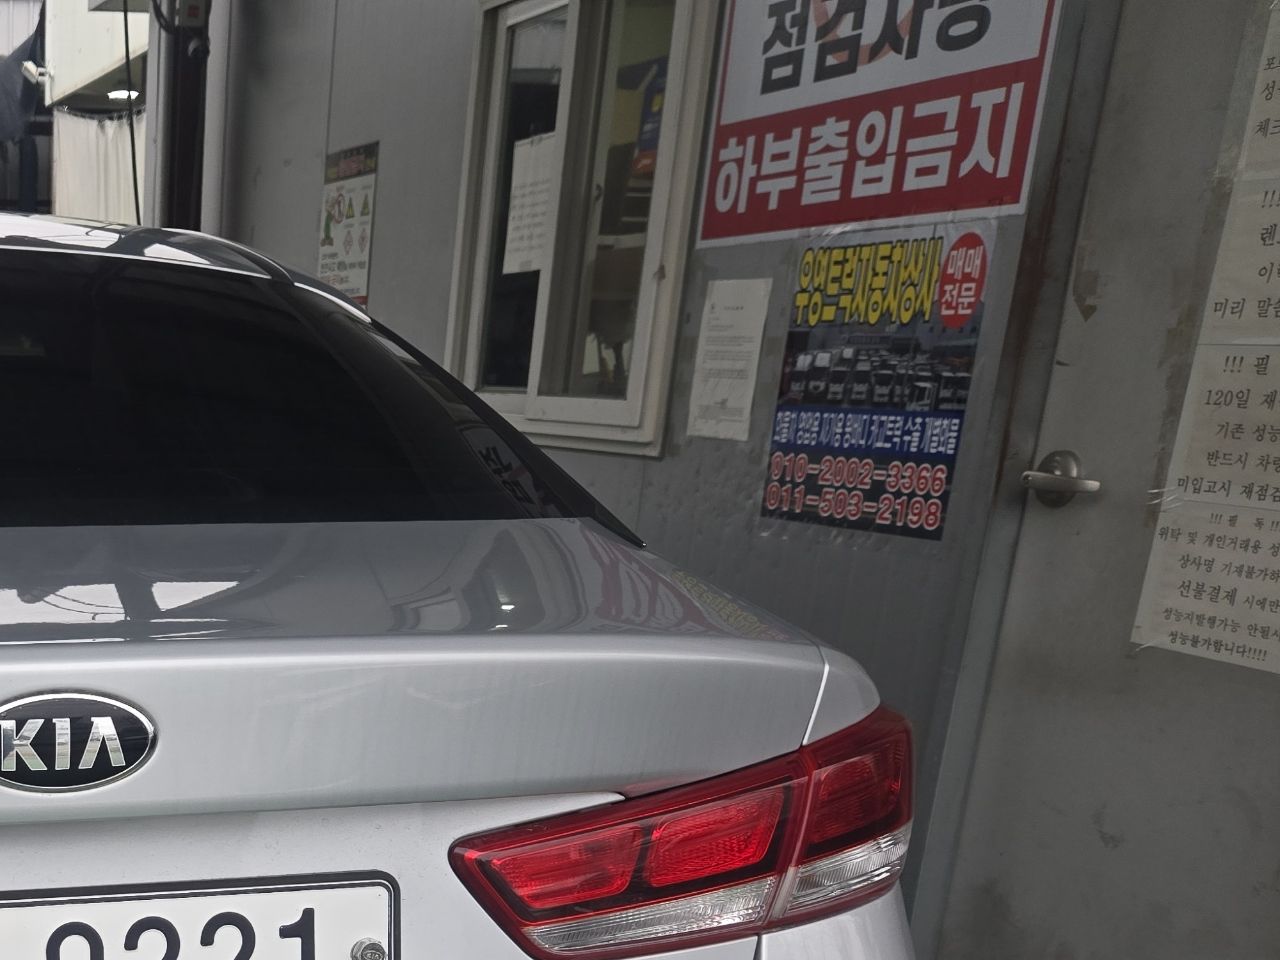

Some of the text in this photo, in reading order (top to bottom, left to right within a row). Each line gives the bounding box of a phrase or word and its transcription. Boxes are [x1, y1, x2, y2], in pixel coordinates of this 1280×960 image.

[714, 81, 1025, 215] 하부출입금지
[946, 245, 985, 280] 매매
[940, 282, 977, 316] 전문
[1213, 298, 1246, 319] 미리
[1253, 354, 1270, 376] 필
[1204, 388, 1251, 409] 120일
[1215, 421, 1245, 440] 기존
[1206, 450, 1249, 470] 반드시
[771, 451, 948, 497] 010-2002-3366
[1177, 475, 1232, 498] 미입고시
[766, 481, 942, 531] 011-503-2198
[1187, 531, 1198, 545] 및
[1178, 553, 1216, 573] 상사명
[1177, 579, 1238, 607] 선불결제
